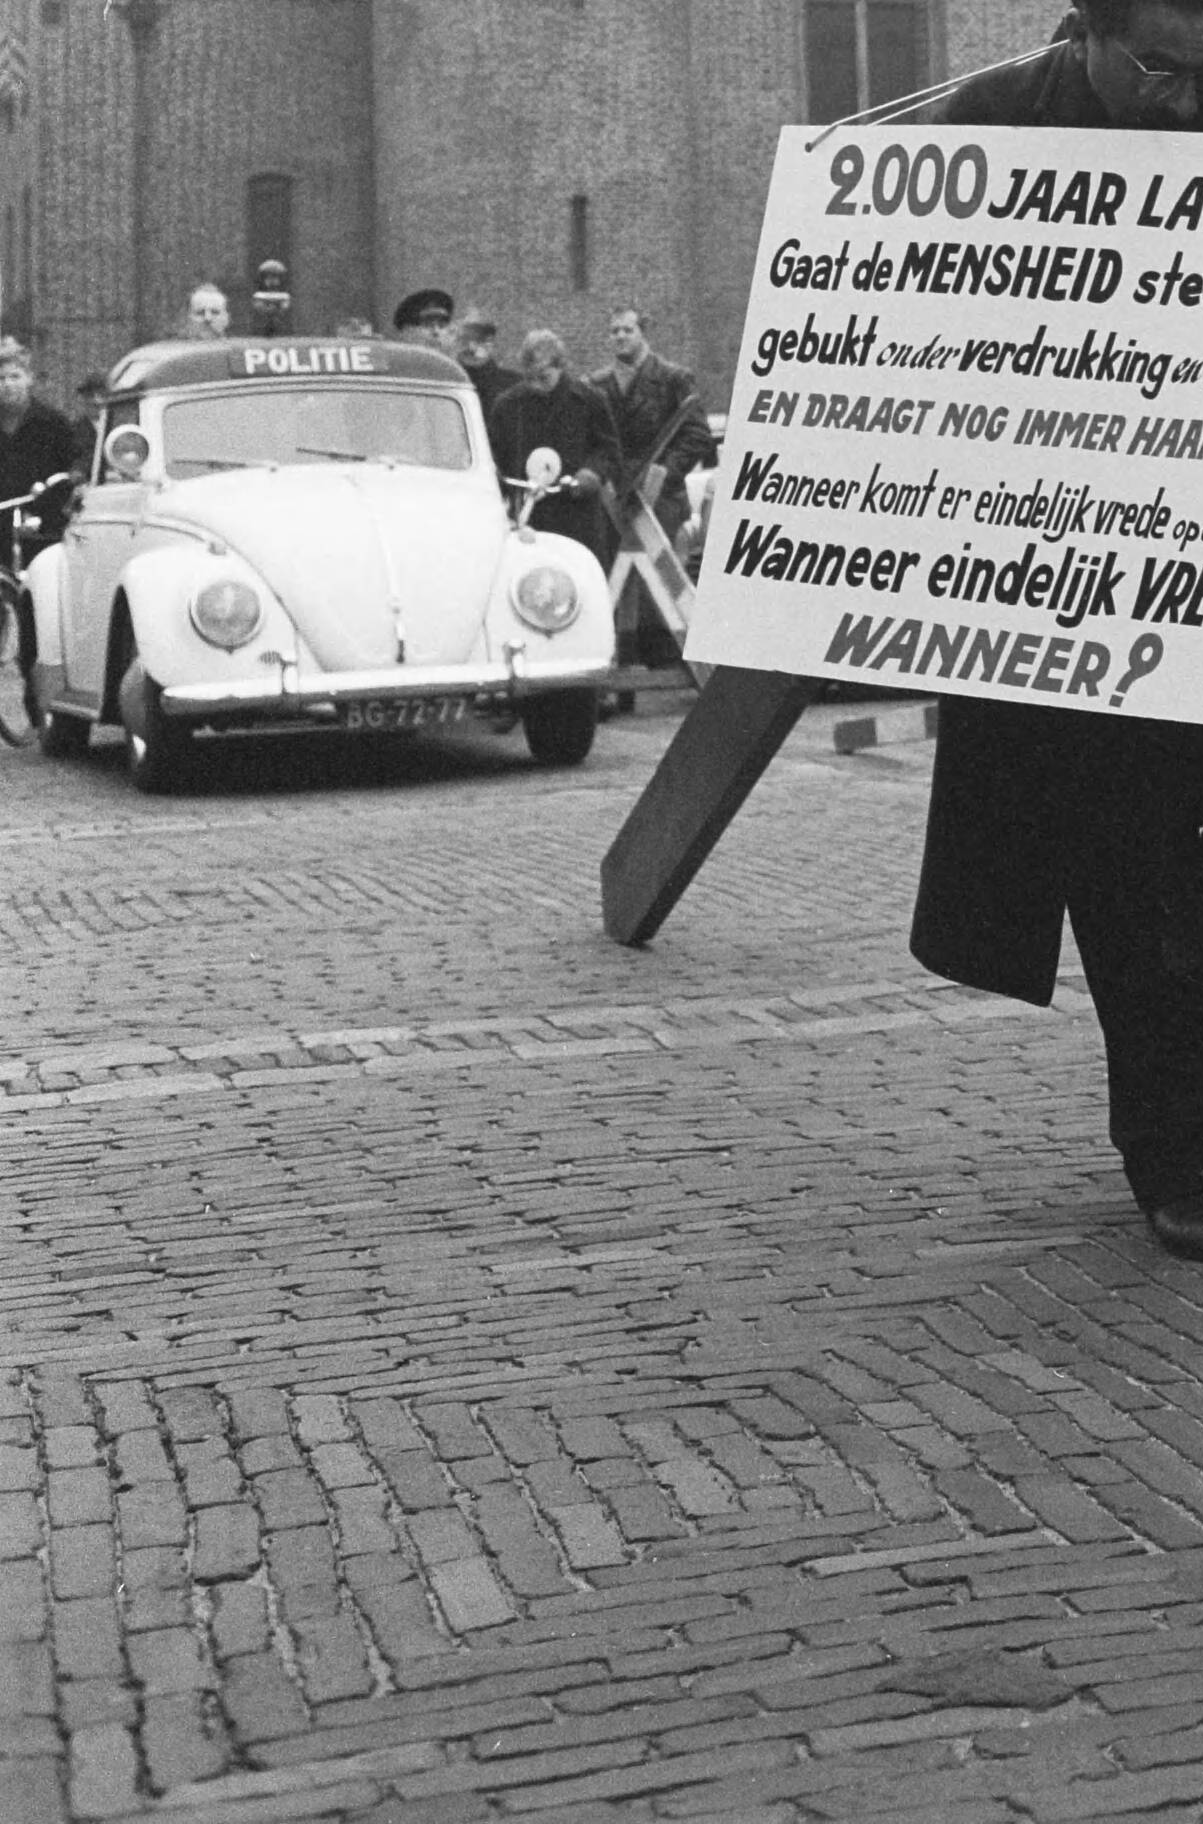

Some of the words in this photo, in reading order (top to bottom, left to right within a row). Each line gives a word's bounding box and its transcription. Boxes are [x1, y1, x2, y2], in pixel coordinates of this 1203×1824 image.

[825, 143, 988, 219] 2.000
[987, 169, 1127, 226] JAAR
[769, 238, 850, 292] Gaat
[851, 240, 893, 293] de
[894, 242, 1123, 304] MENSHEID
[244, 346, 374, 374] POLITIE
[751, 313, 879, 377] gebukt
[876, 333, 962, 372] onder
[958, 325, 1174, 400] verdrukking
[747, 389, 801, 427] EN
[802, 393, 936, 437] DRAAGT
[938, 402, 1009, 443] NOG
[1013, 408, 1126, 453] IMMER
[731, 451, 861, 511] Wanneer
[859, 463, 940, 518] komt
[937, 486, 973, 522] er
[974, 478, 1096, 544] eindelijk
[1093, 486, 1171, 540] vrede
[1173, 519, 1201, 553] op
[724, 519, 921, 594] Wanneer
[928, 542, 1126, 628] eindelijk
[824, 612, 1165, 708] WANNEER?
